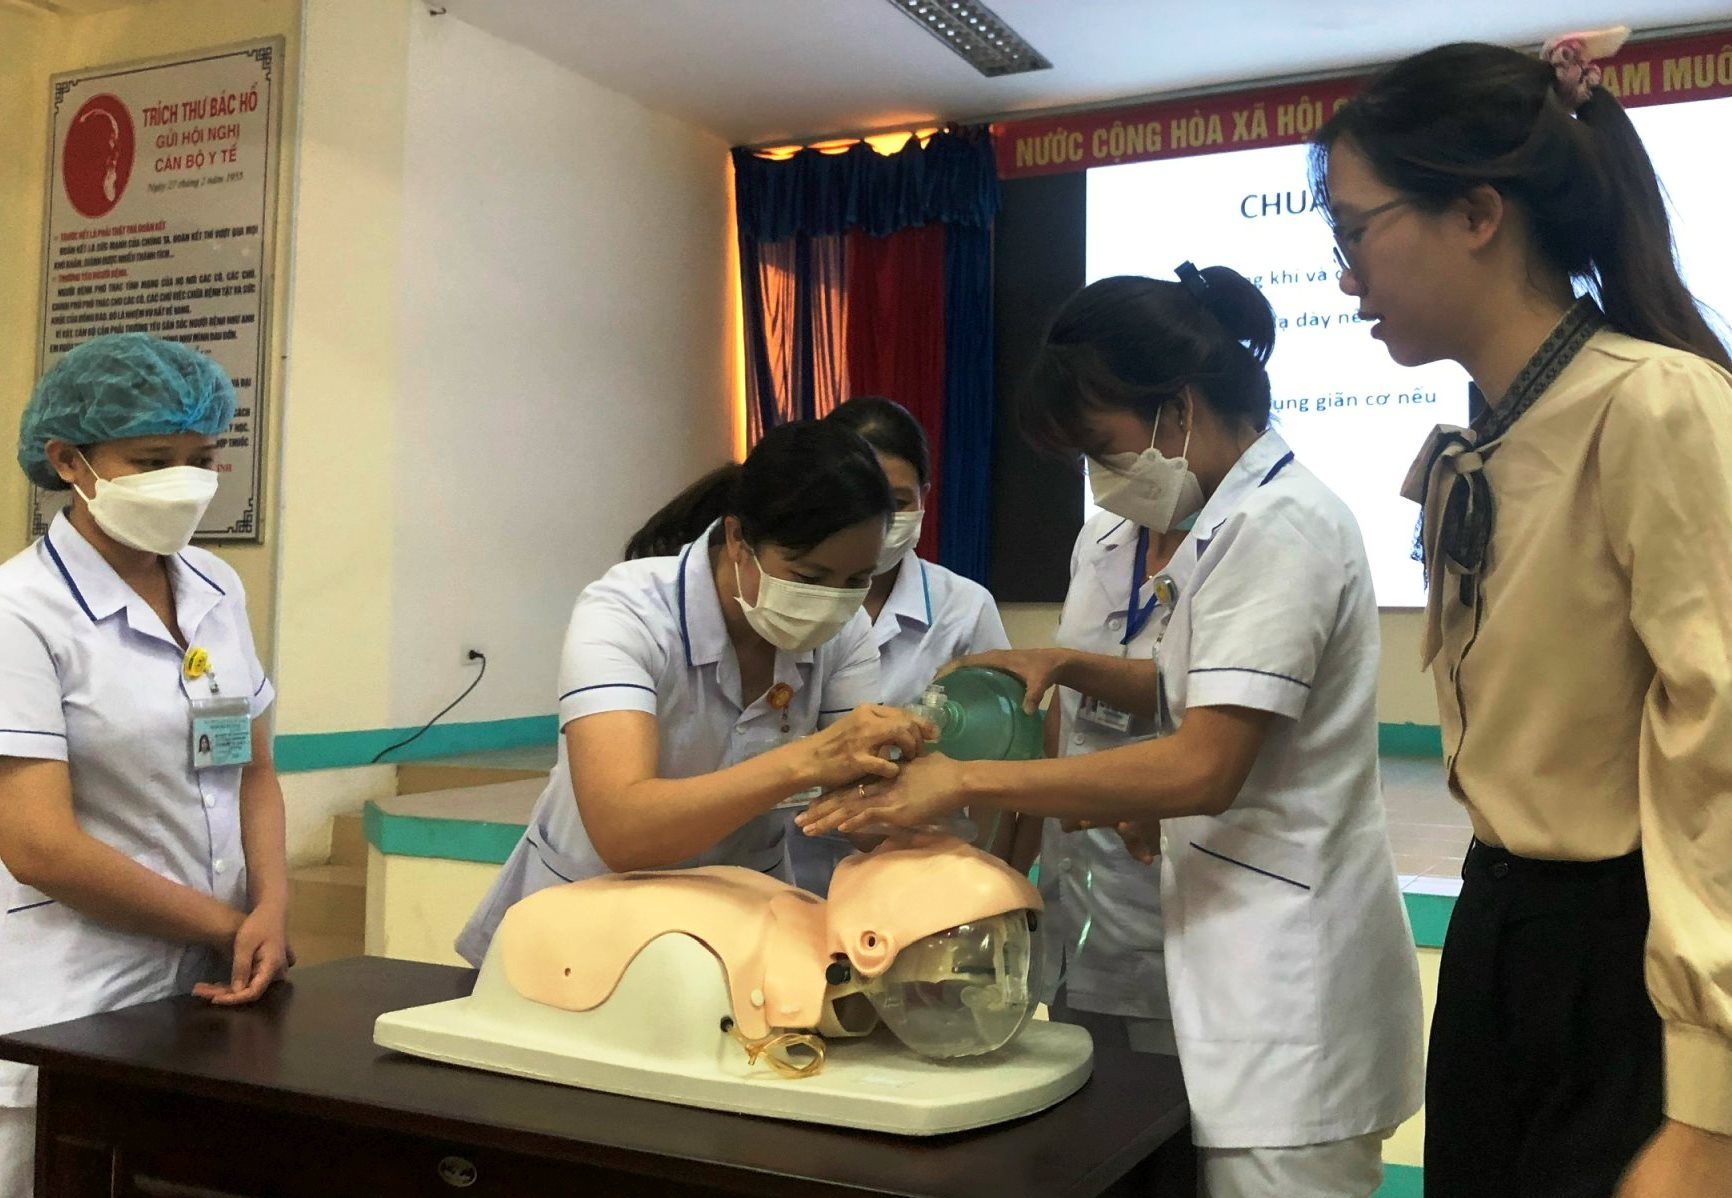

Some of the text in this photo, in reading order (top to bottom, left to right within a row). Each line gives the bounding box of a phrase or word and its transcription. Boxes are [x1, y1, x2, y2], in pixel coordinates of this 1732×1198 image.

[1602, 44, 1732, 98] AM MUÔ
[142, 100, 179, 127] TRÍCH
[182, 96, 208, 122] THƯ
[210, 89, 236, 118] BÁC
[181, 125, 204, 146] HỘI
[208, 123, 240, 141] NGHỊ
[1015, 127, 1084, 167] NƯỚC
[1092, 120, 1162, 164] CỘNG
[1170, 108, 1223, 149] HÒA
[1232, 102, 1268, 142] XÃ
[1277, 95, 1323, 141] HỘI
[208, 151, 217, 165] Y
[220, 142, 238, 164] TẾ
[1240, 190, 1317, 218] CHU
[1296, 311, 1331, 329] dày
[1272, 386, 1436, 412] ụng giãn cơ nếu
